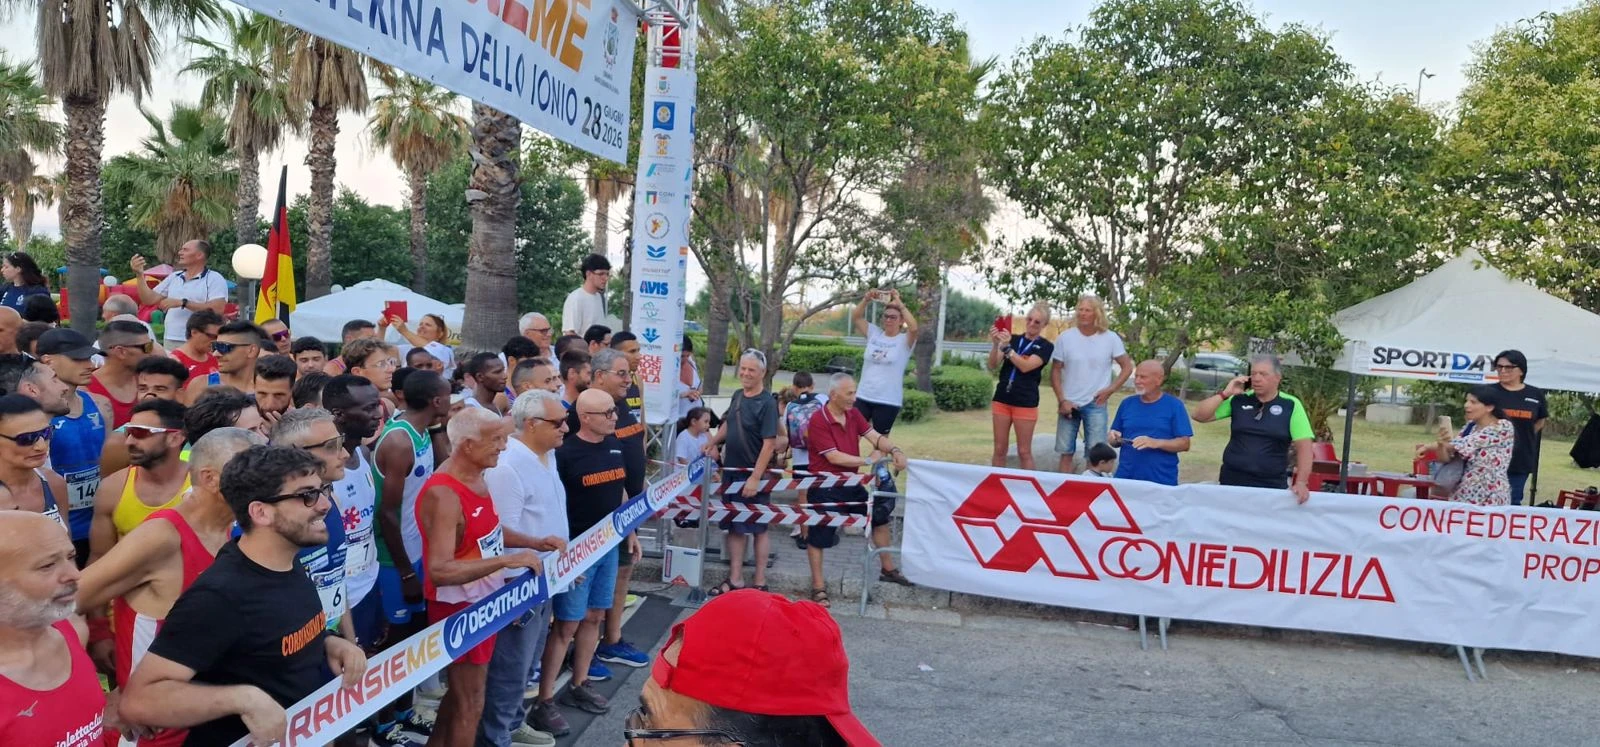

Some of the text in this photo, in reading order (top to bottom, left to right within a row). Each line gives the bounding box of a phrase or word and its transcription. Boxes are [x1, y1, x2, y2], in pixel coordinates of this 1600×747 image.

[461, 21, 525, 98] DELLO
[531, 64, 577, 126] IONIO
[581, 96, 601, 140] 28
[602, 122, 622, 149] 2026
[640, 280, 668, 295] AVIS
[557, 520, 615, 577] CORRINSIEME
[1379, 505, 1600, 546] CONFEDERAZI
[1098, 536, 1395, 602] CONFEDILIZIA
[1523, 553, 1600, 582] PROP
[333, 587, 341, 607] 6
[468, 576, 539, 634] DECATHLON
[246, 629, 441, 747] RRINSIEME
